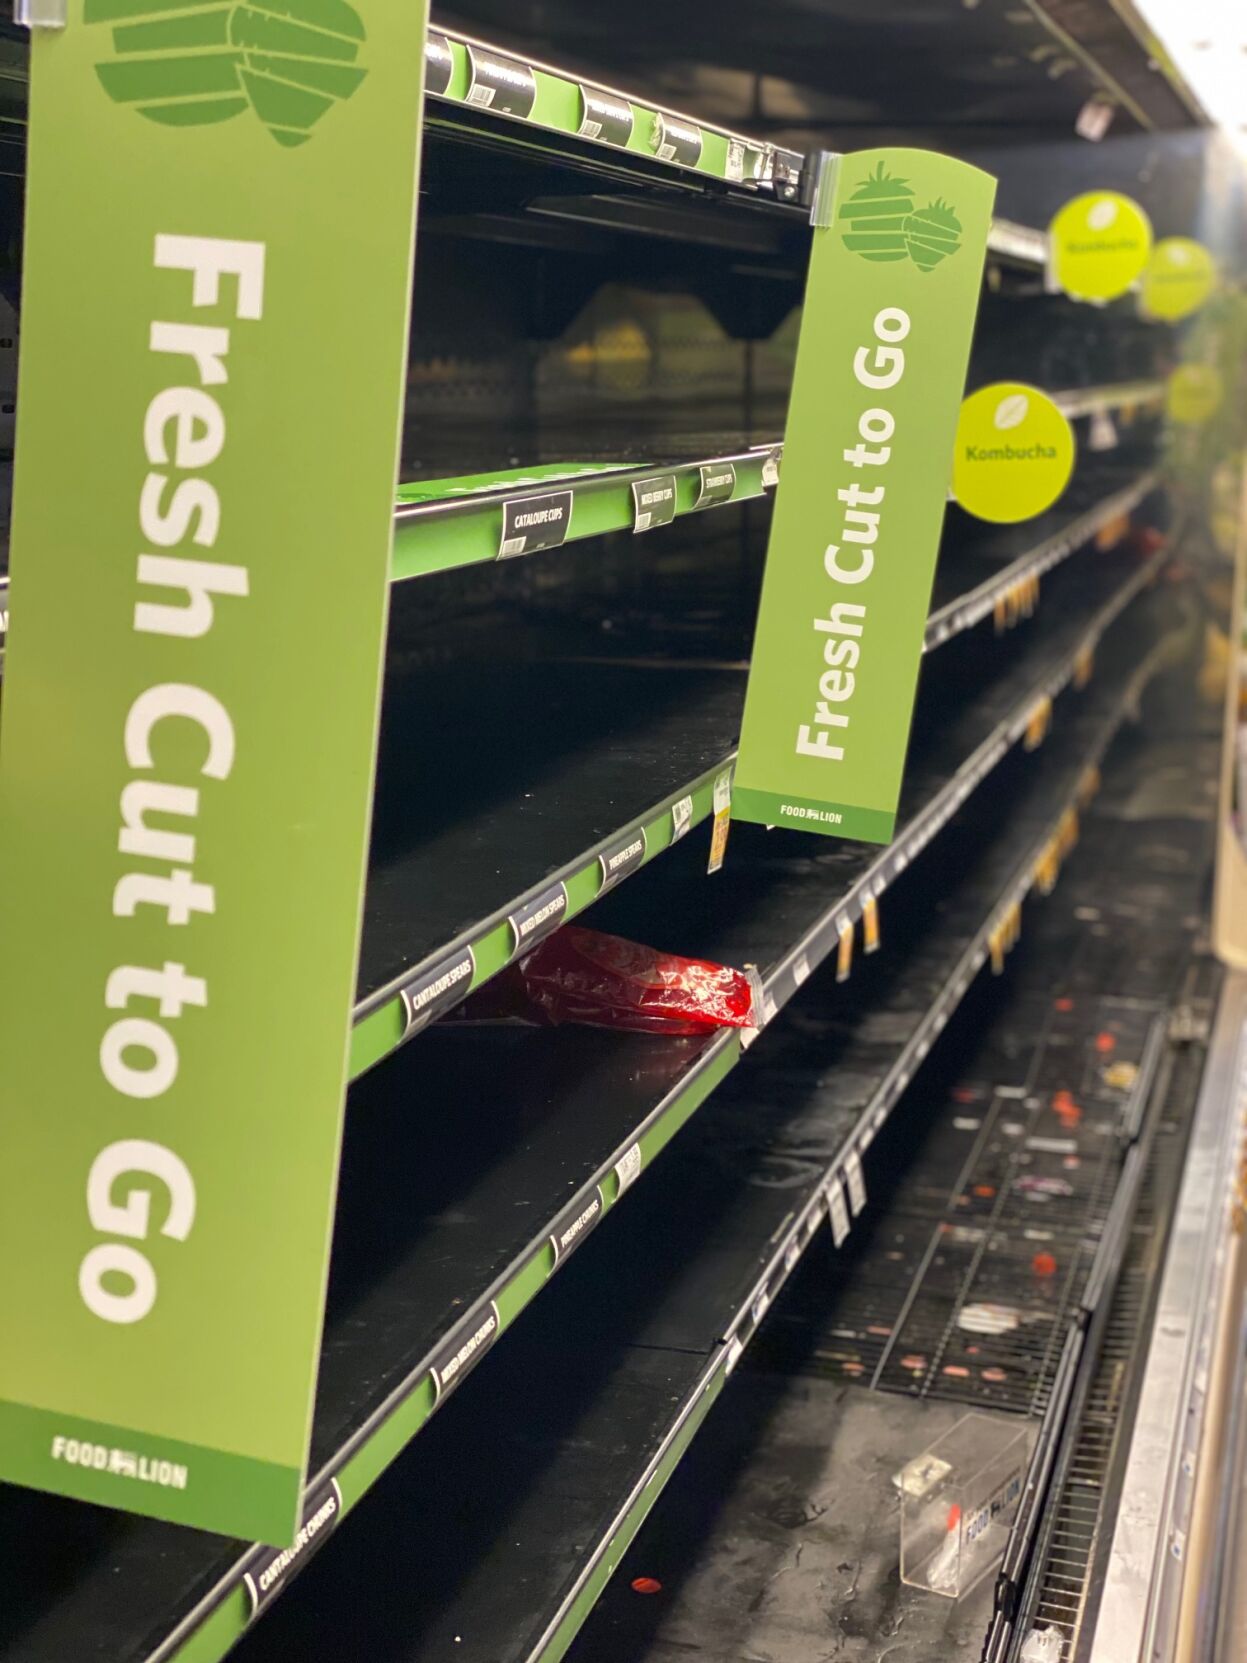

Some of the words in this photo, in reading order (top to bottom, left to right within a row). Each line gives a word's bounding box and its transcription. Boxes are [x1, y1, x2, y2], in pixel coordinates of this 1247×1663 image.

[853, 307, 911, 390] Go
[134, 234, 266, 637] Fresh
[843, 408, 896, 468] to
[965, 443, 1057, 462] Kombucha
[514, 509, 549, 529] CATALOUPE
[548, 507, 563, 522] CUPS
[824, 483, 885, 585] Cut
[795, 602, 866, 761] Fresh
[113, 683, 235, 924] Cut
[780, 804, 806, 818] FOOD
[819, 811, 842, 824] LION
[548, 894, 565, 915] SPEARS
[413, 973, 451, 1010] CANTALOUPE
[449, 959, 472, 985] SPEARS
[100, 962, 207, 1098] to
[79, 1139, 196, 1323] Go
[474, 1315, 496, 1345] CHUNKS
[52, 1436, 107, 1470] FOOD
[138, 1456, 188, 1490] LION
[306, 1496, 337, 1538] CHUNKS
